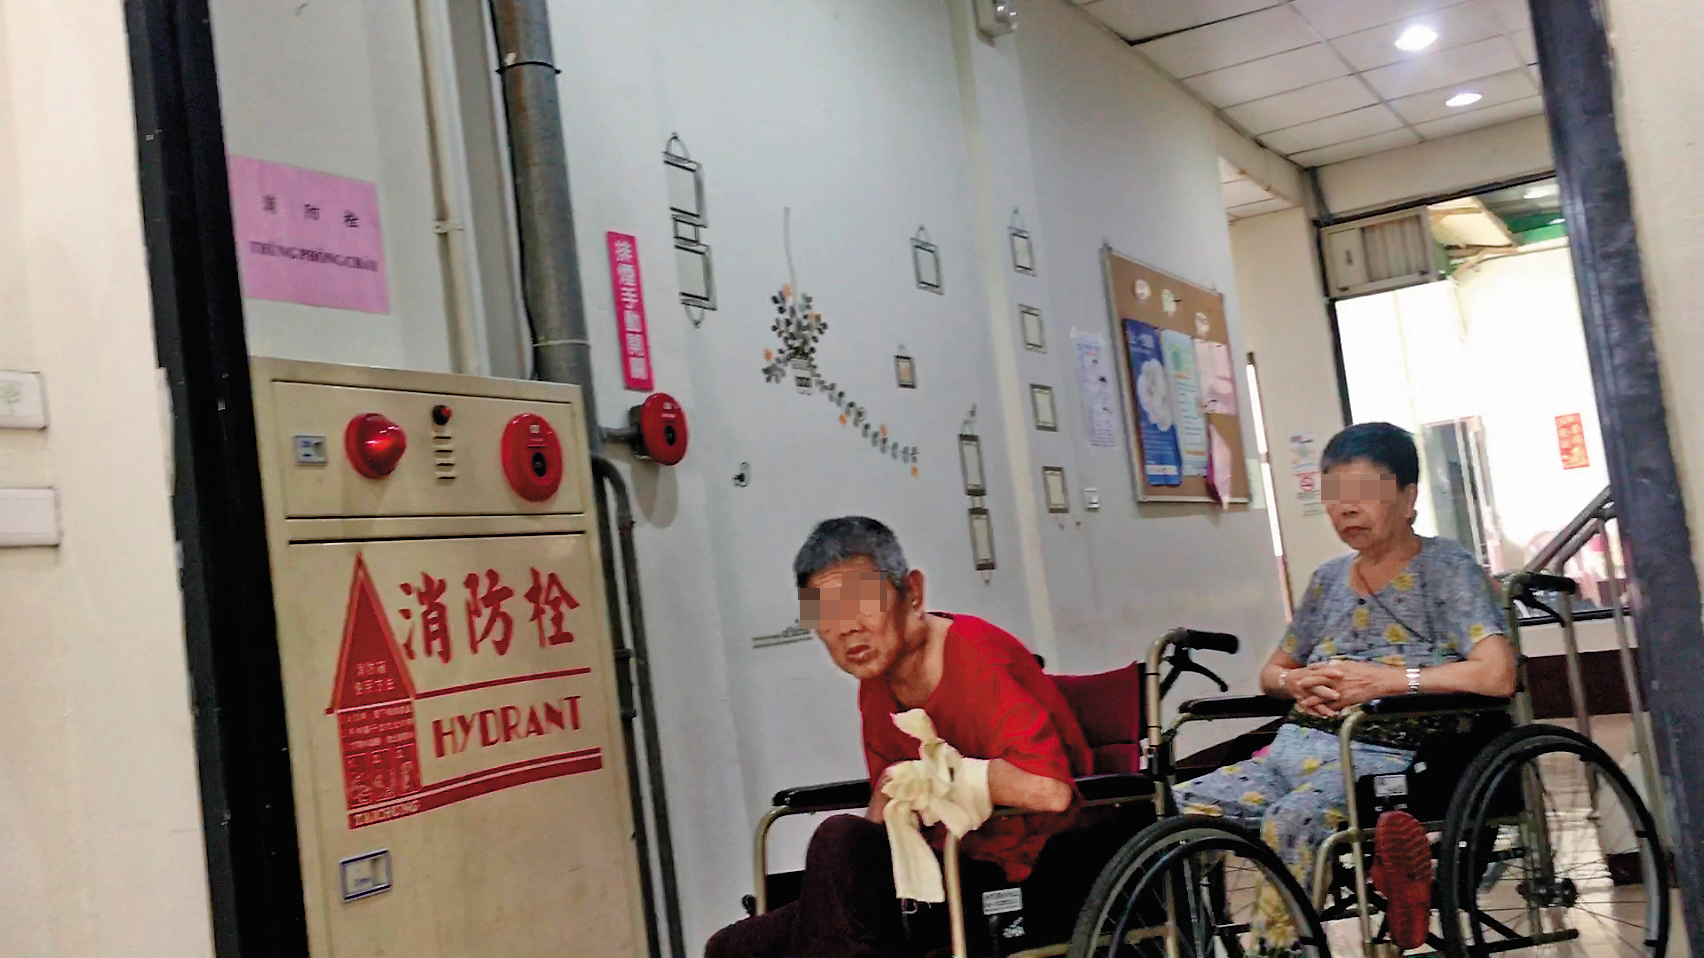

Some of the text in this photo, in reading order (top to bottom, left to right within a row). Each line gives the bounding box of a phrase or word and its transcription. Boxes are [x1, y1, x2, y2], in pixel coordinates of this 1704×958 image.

[397, 566, 581, 664] 消防栓
[431, 695, 582, 759] HYDRANT
